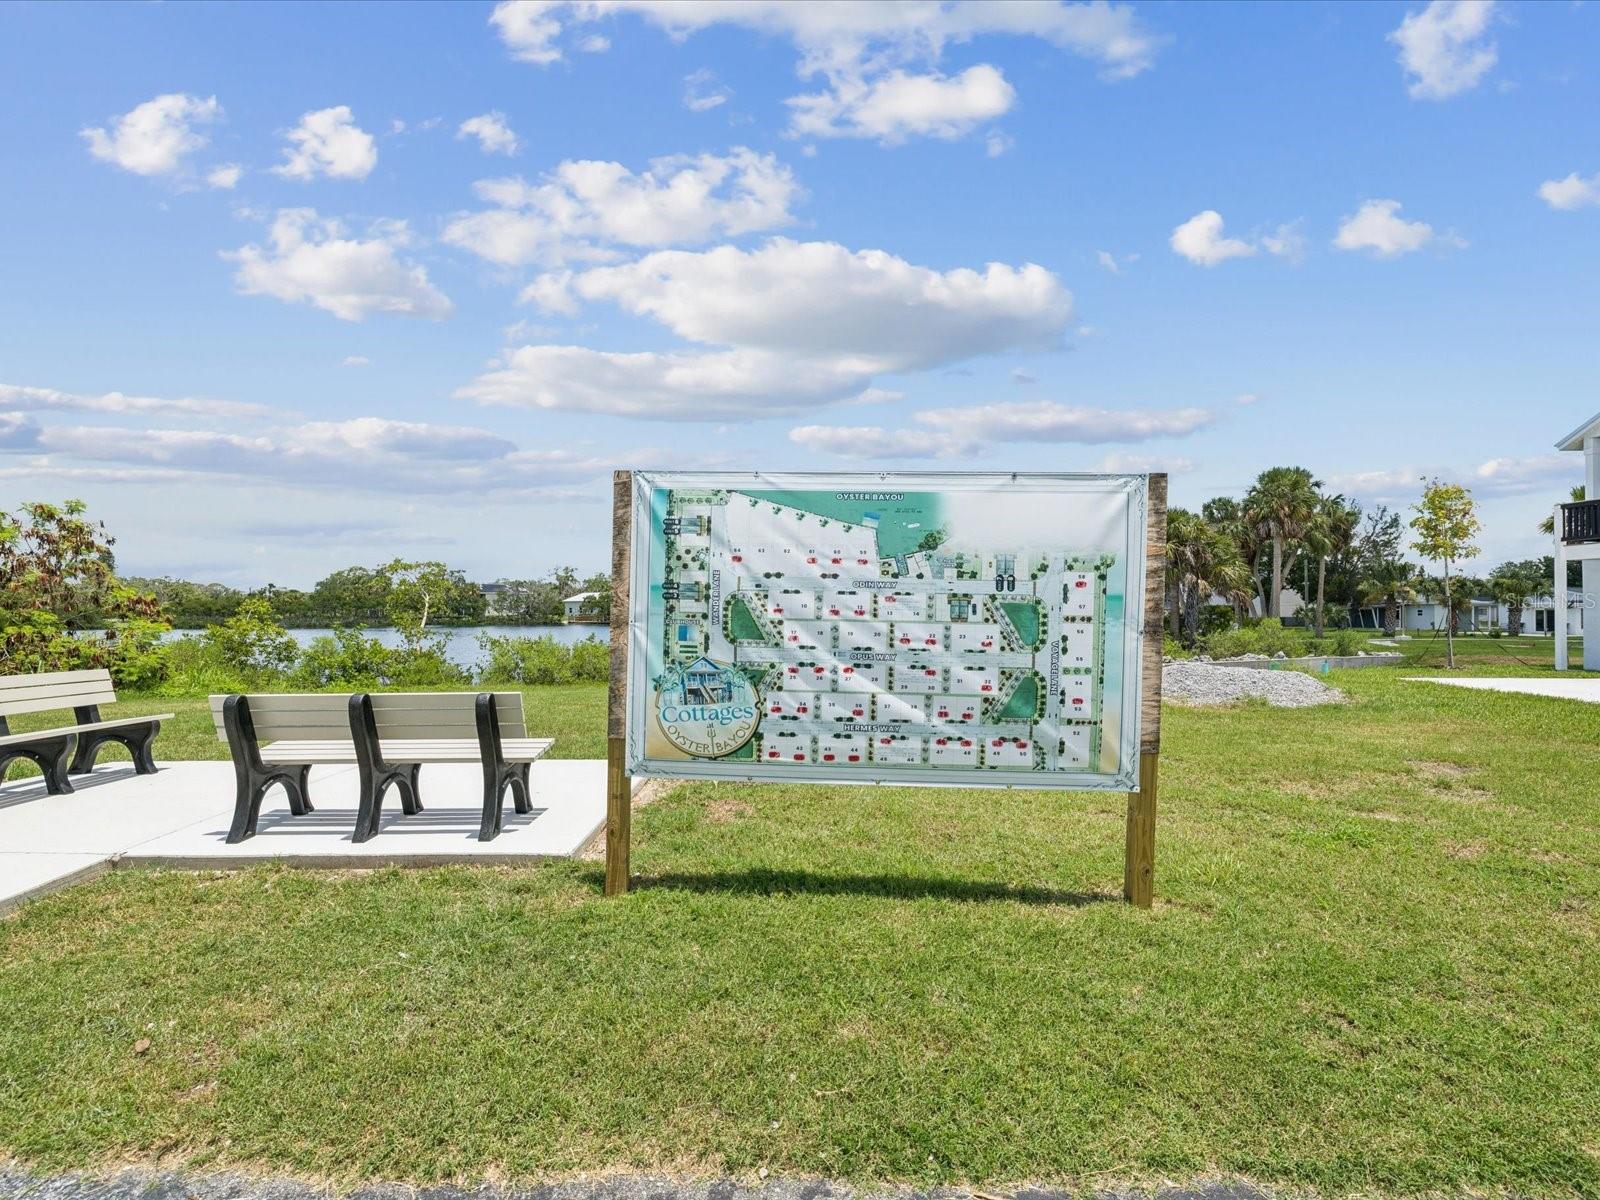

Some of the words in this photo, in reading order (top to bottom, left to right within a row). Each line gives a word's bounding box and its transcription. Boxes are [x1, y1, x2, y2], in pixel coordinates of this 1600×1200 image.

[836, 493, 870, 501] OYSTER
[872, 493, 904, 501] BAYOU
[712, 570, 721, 591] LANE
[852, 581, 876, 589] ODIN
[712, 590, 720, 626] WANDER
[850, 653, 874, 661] OPUS
[874, 653, 897, 661] WAY
[1050, 640, 1059, 675] VOYAGE
[1050, 674, 1059, 696] LANE
[662, 706, 754, 726] Cottages
[667, 725, 710, 753] OYSTER
[715, 721, 751, 752] BAYOU
[844, 724, 878, 732] HERMES
[879, 724, 901, 733] WAY
